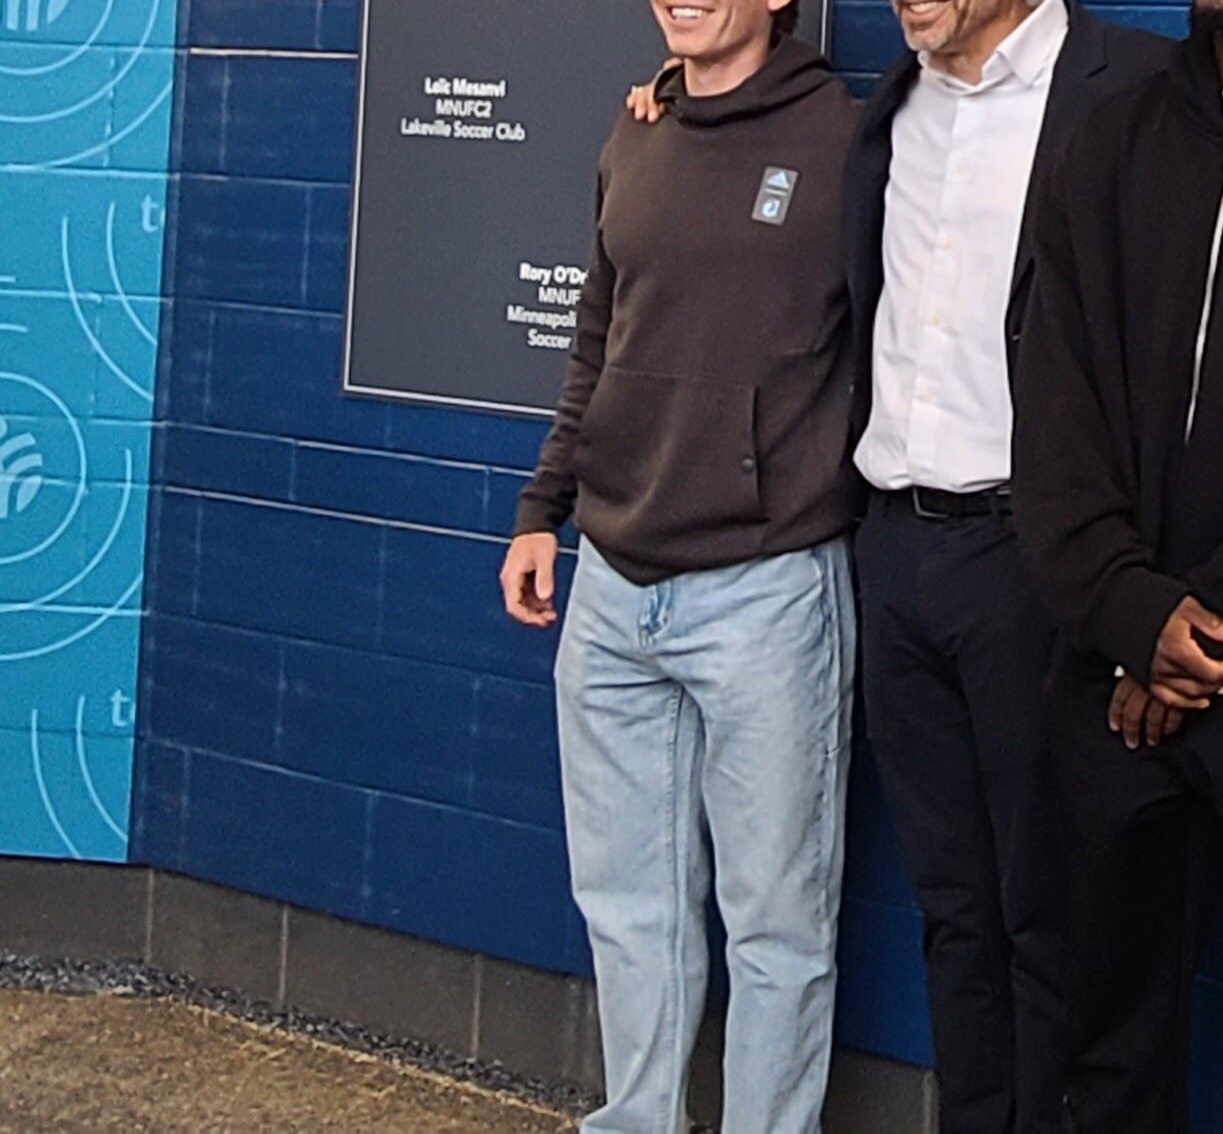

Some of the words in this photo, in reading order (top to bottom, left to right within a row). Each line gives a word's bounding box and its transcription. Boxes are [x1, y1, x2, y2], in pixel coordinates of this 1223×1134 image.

[436, 98, 492, 118] MNUFC2
[401, 118, 451, 137] Lakeville
[454, 120, 494, 139] Soccer
[496, 122, 525, 141] Club
[519, 262, 552, 285] Rory
[554, 265, 588, 284] O'Dr
[538, 286, 582, 304] MNUF
[507, 305, 576, 329] Minneapoli
[528, 328, 572, 348] Soccer
